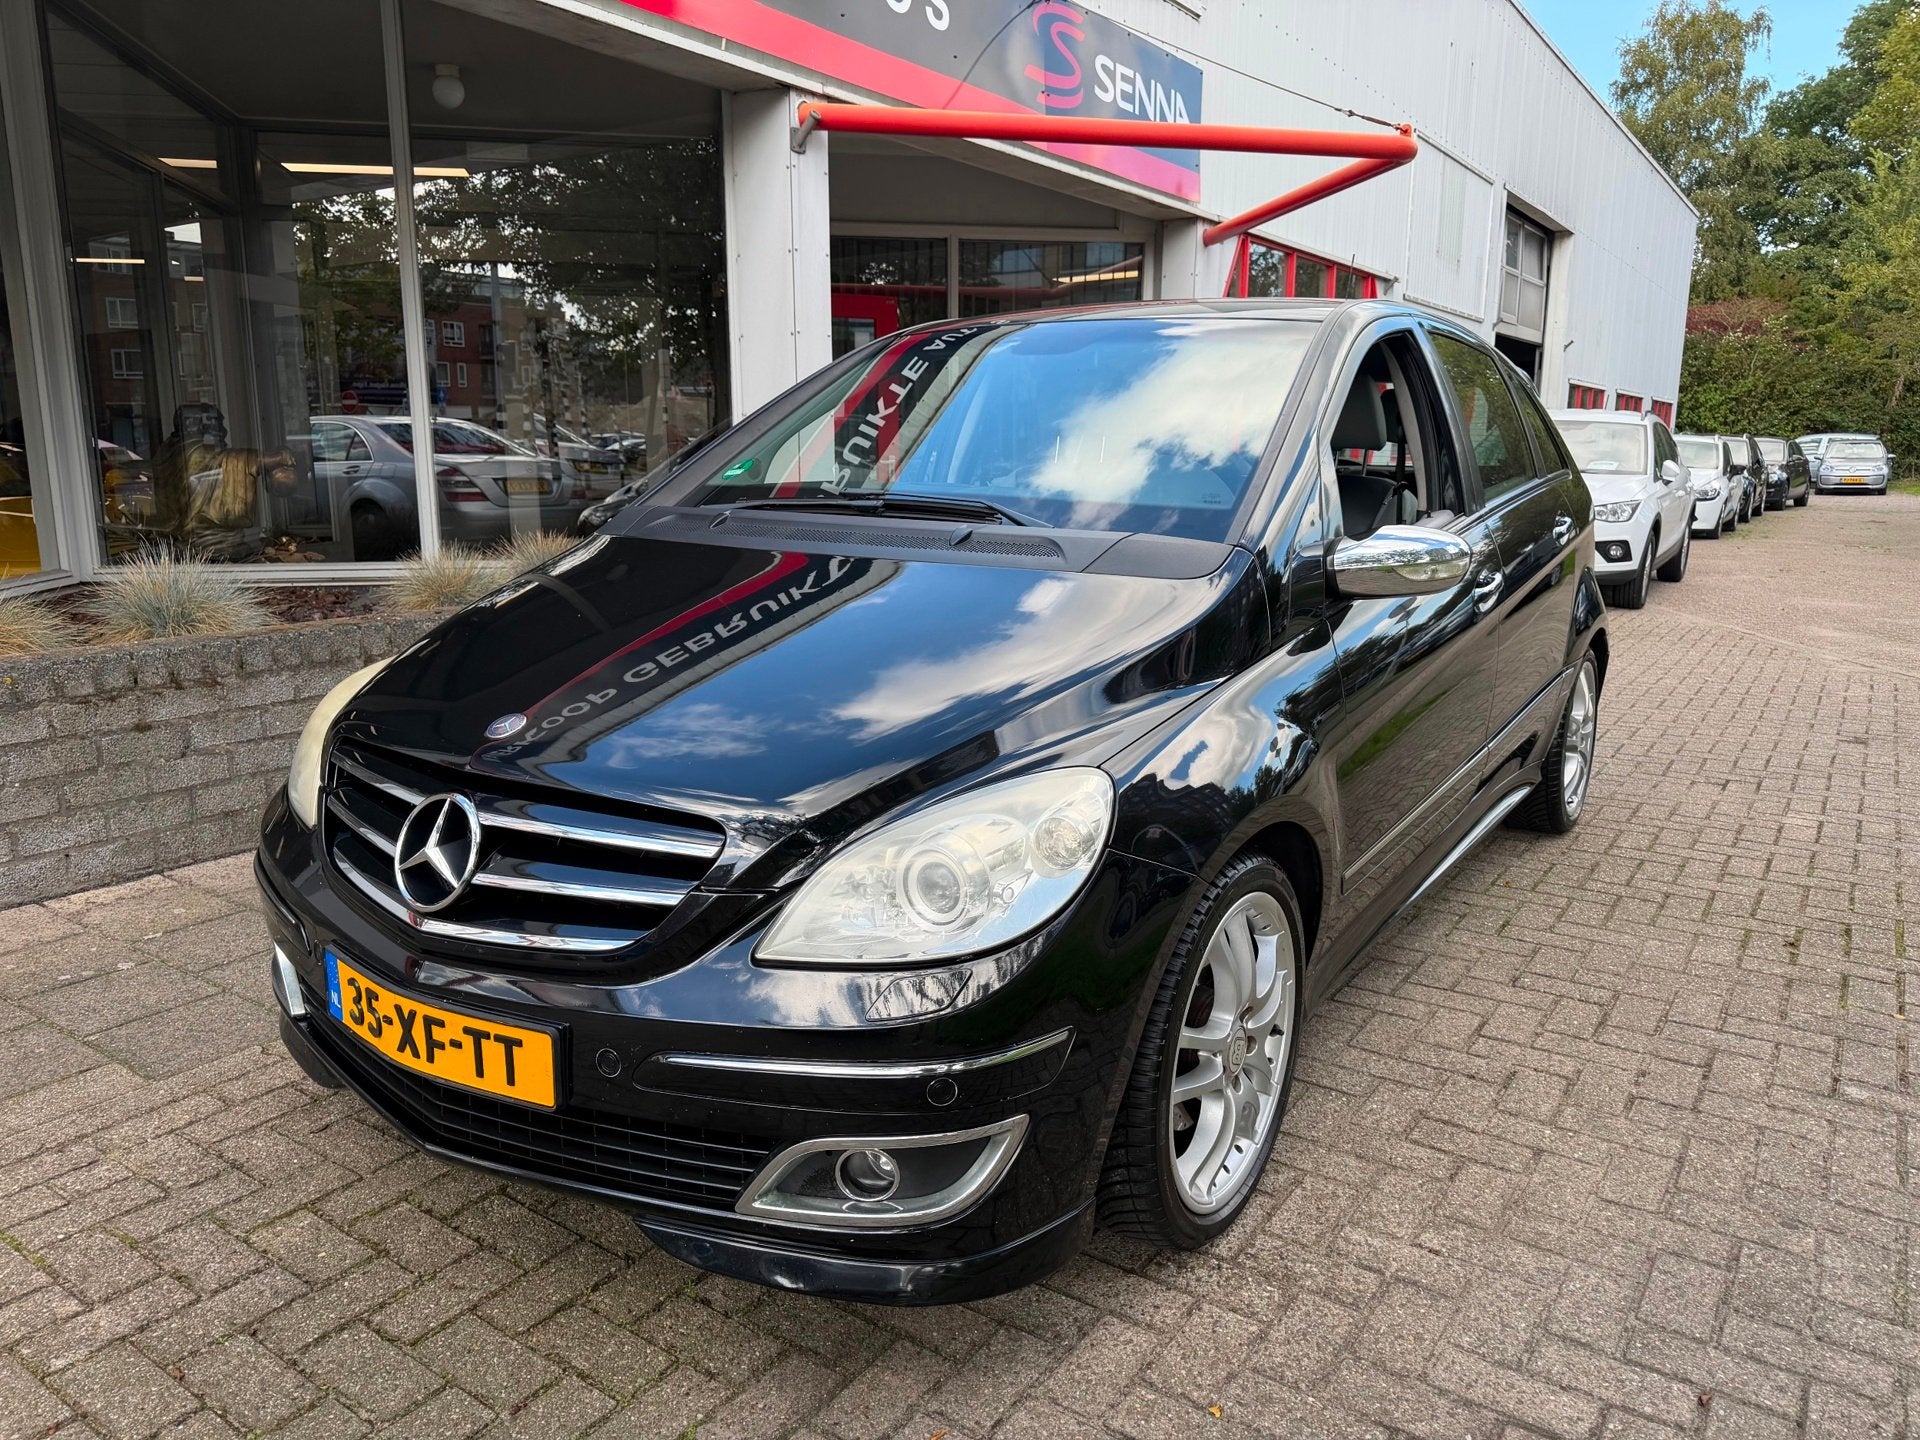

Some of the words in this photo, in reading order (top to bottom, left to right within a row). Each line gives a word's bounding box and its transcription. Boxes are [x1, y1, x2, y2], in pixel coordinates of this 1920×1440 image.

[1094, 54, 1190, 124] SENNA
[331, 989, 341, 1009] NL
[347, 977, 523, 1087] 35-XF-TT
